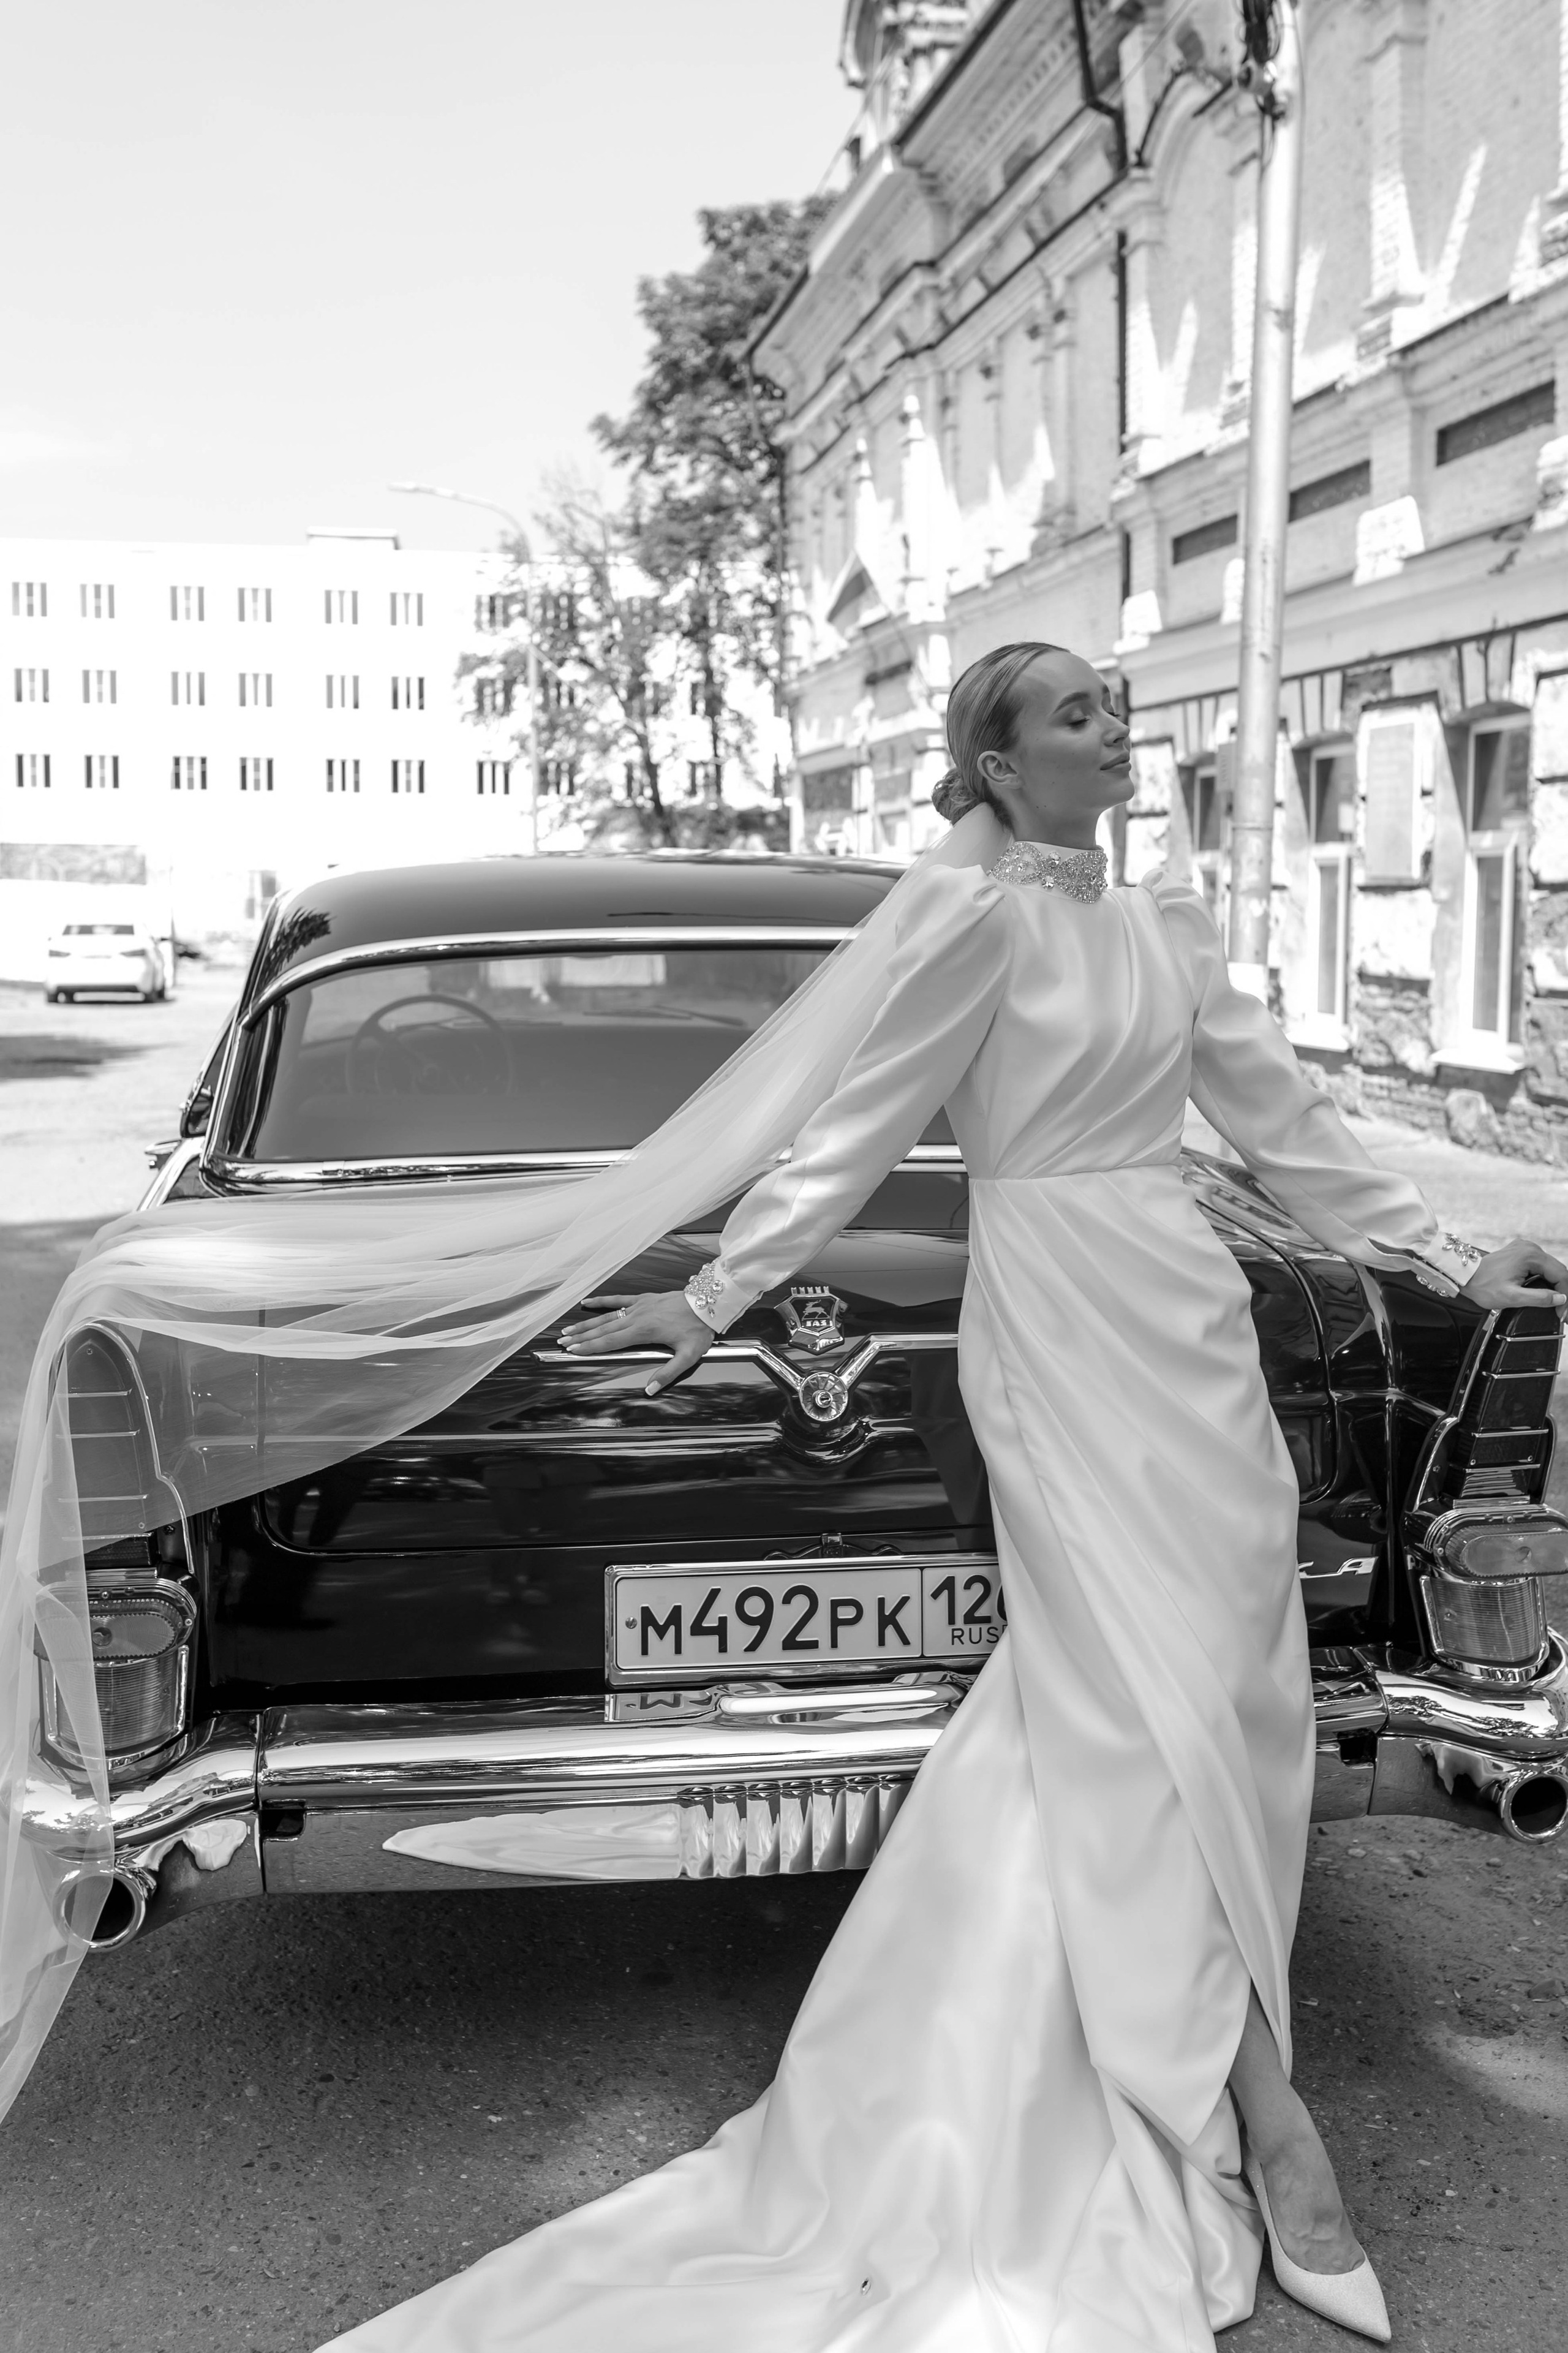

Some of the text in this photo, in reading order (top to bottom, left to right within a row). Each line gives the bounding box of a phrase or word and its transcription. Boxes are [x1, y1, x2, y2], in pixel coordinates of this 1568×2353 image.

[640, 1574, 1008, 1656] М492РК 12
[951, 1626, 1000, 1645] RUS
